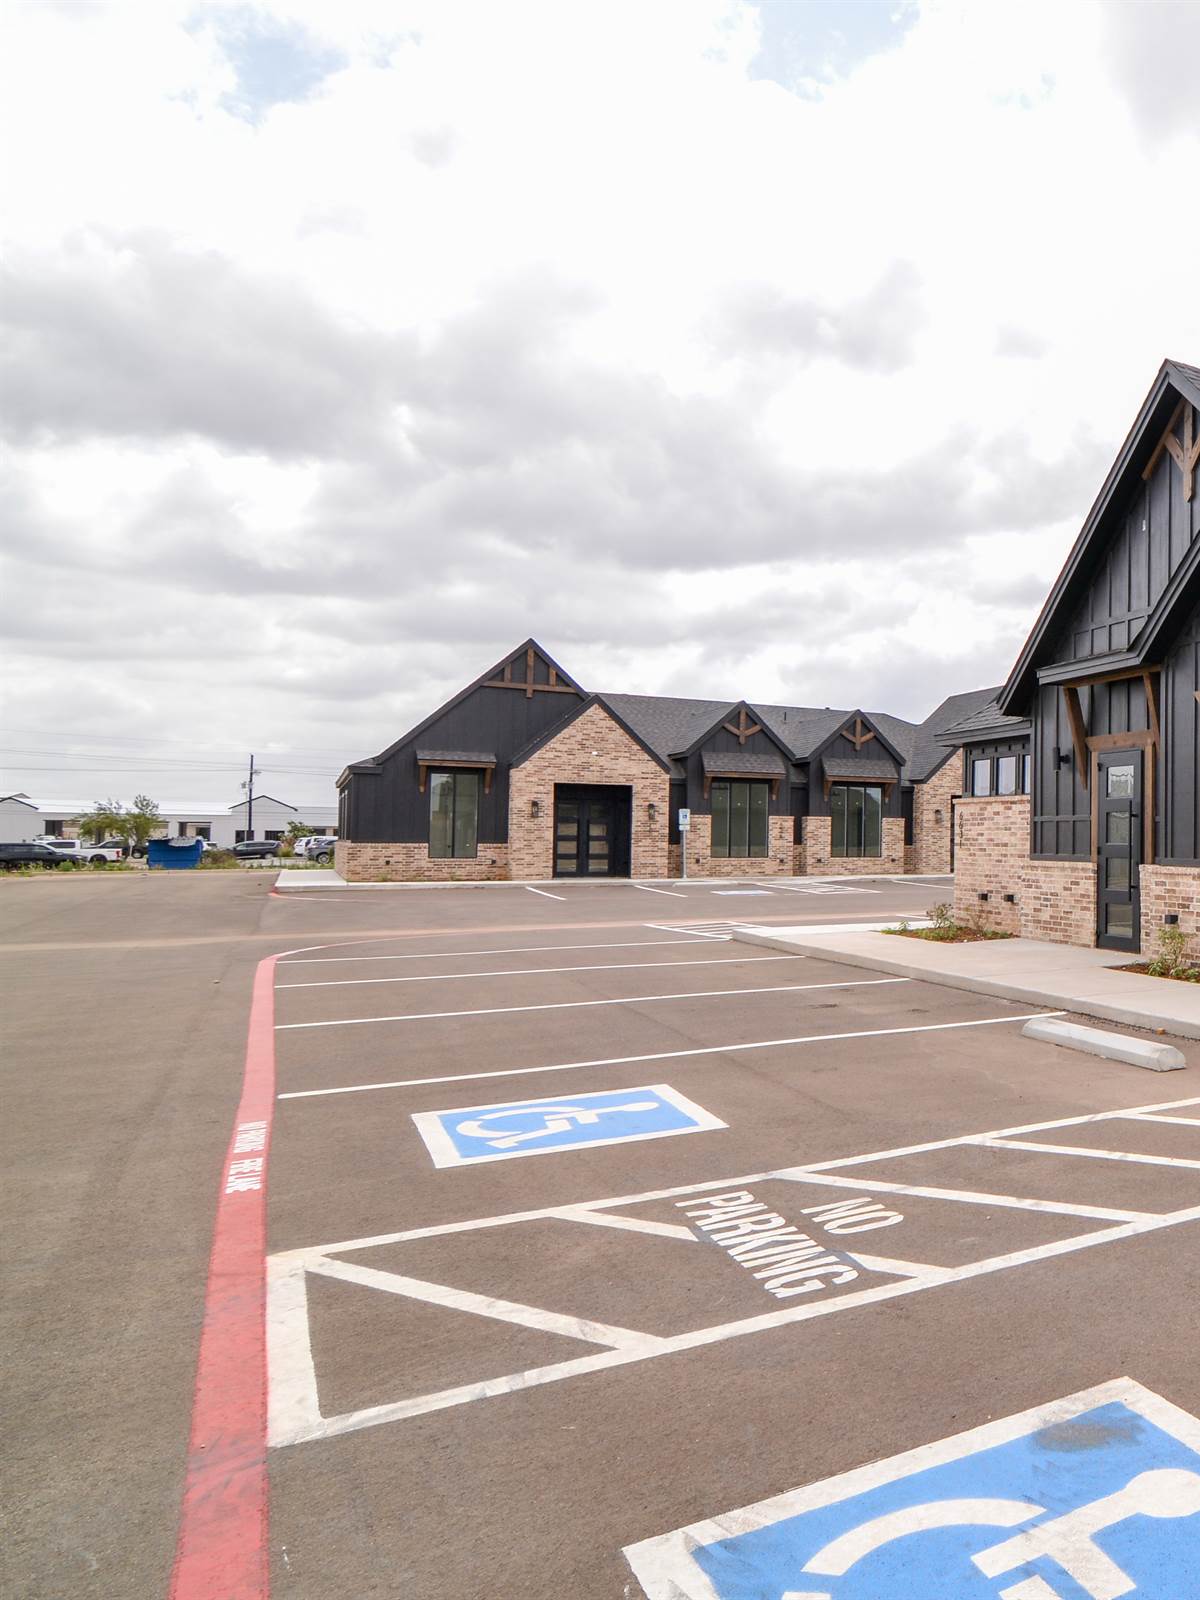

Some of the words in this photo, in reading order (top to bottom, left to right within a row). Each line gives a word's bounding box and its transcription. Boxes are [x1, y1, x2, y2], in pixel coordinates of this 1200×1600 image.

[229, 1158, 264, 1176] FIRE
[224, 1172, 262, 1194] LANE
[800, 1197, 904, 1235] NO
[674, 1190, 859, 1299] PARKING
